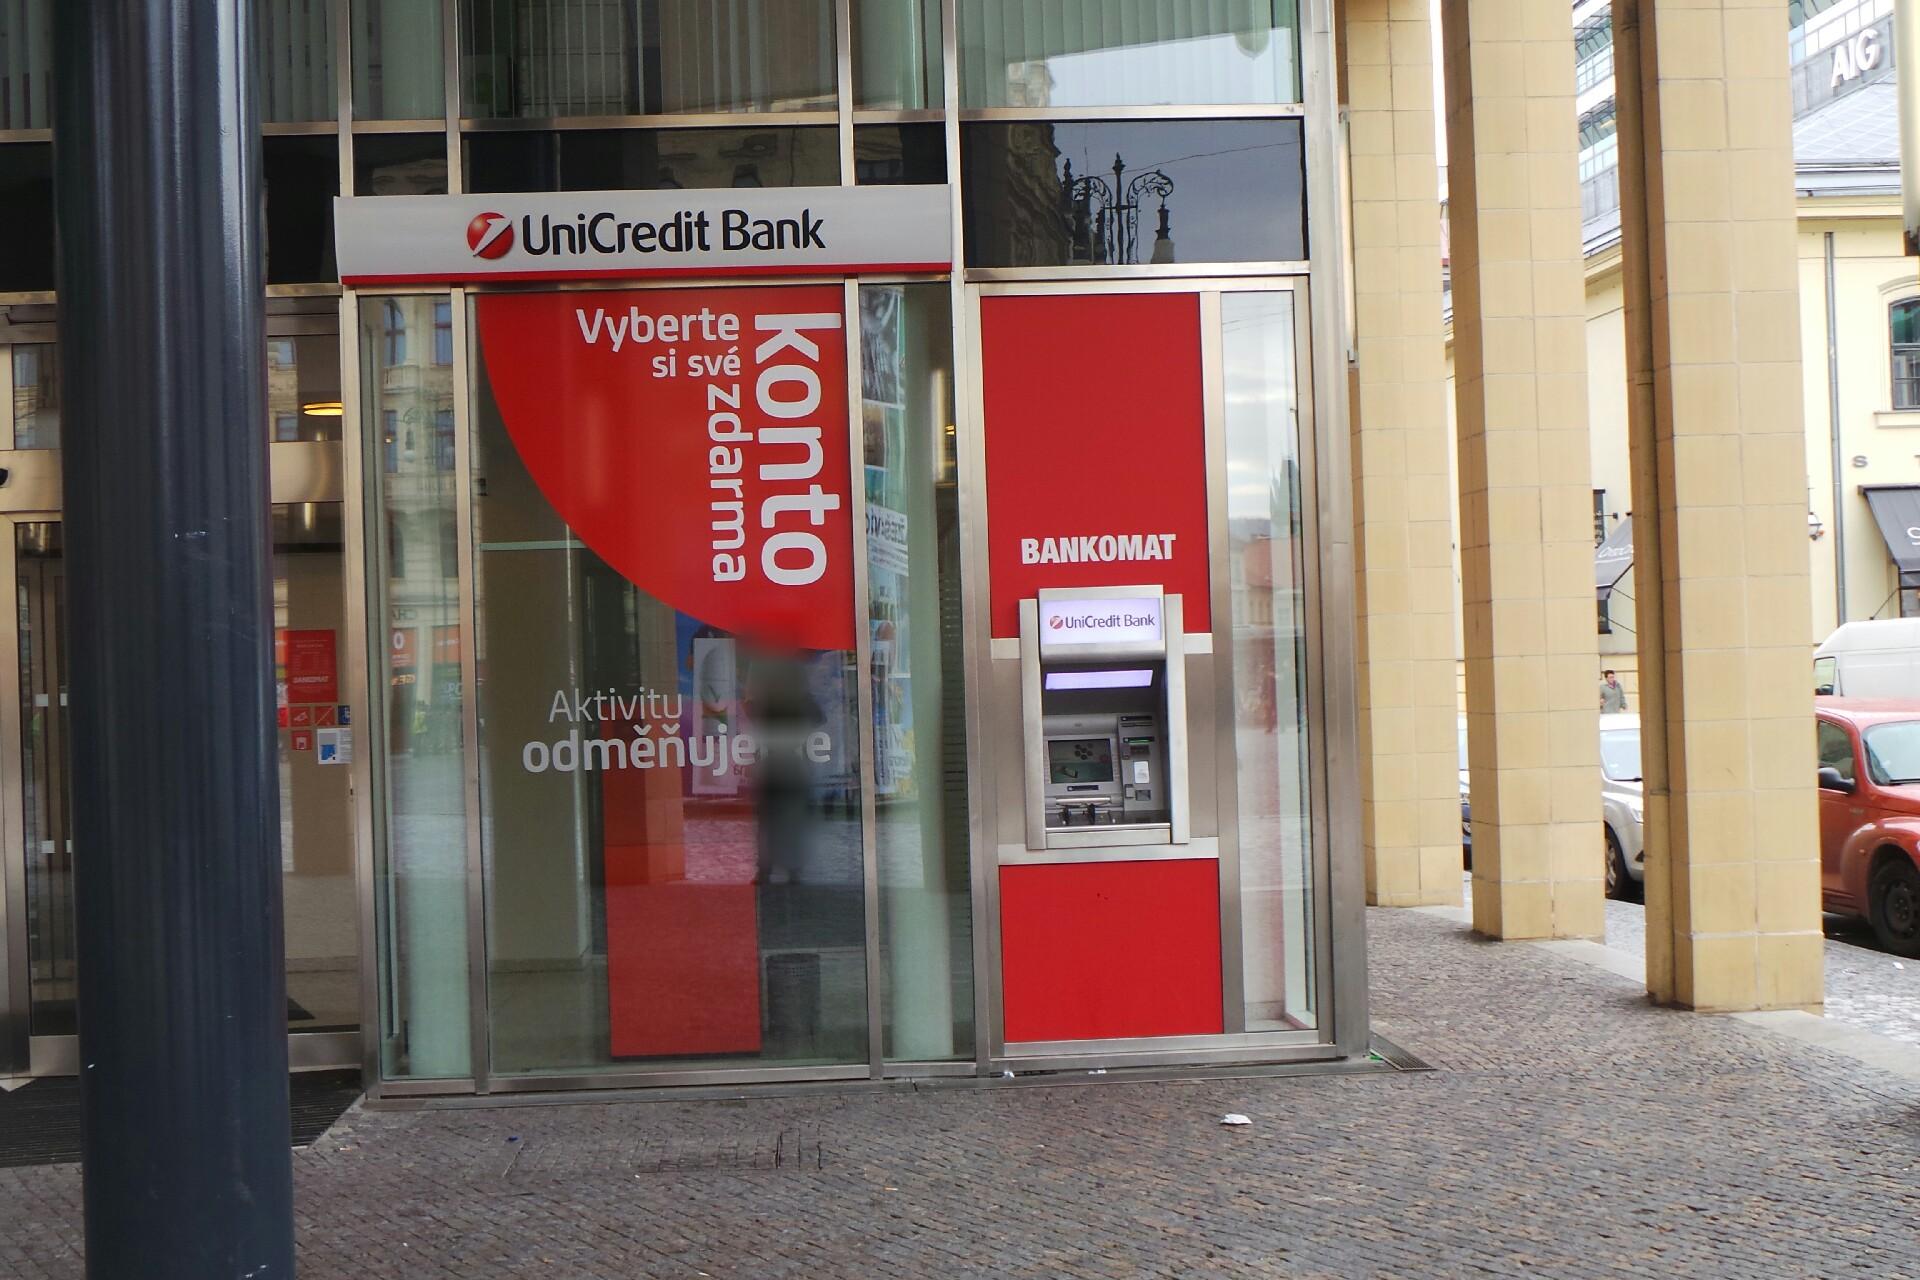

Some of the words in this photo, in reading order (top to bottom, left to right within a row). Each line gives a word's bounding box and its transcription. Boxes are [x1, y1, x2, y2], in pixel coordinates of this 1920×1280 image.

[1831, 28, 1881, 88] AIG
[522, 210, 710, 256] UniCredit
[721, 208, 826, 251] Bank
[576, 306, 740, 353] Vyberte
[652, 348, 677, 378] si
[687, 345, 742, 377] své
[754, 312, 842, 586] konto
[706, 383, 754, 582] zdarma
[1021, 533, 1177, 565] BANKOMAT
[1065, 614, 1121, 629] UniCredit
[1124, 613, 1156, 627] Bank
[548, 687, 684, 723] Aktivitu
[521, 723, 833, 777] odměňujee
